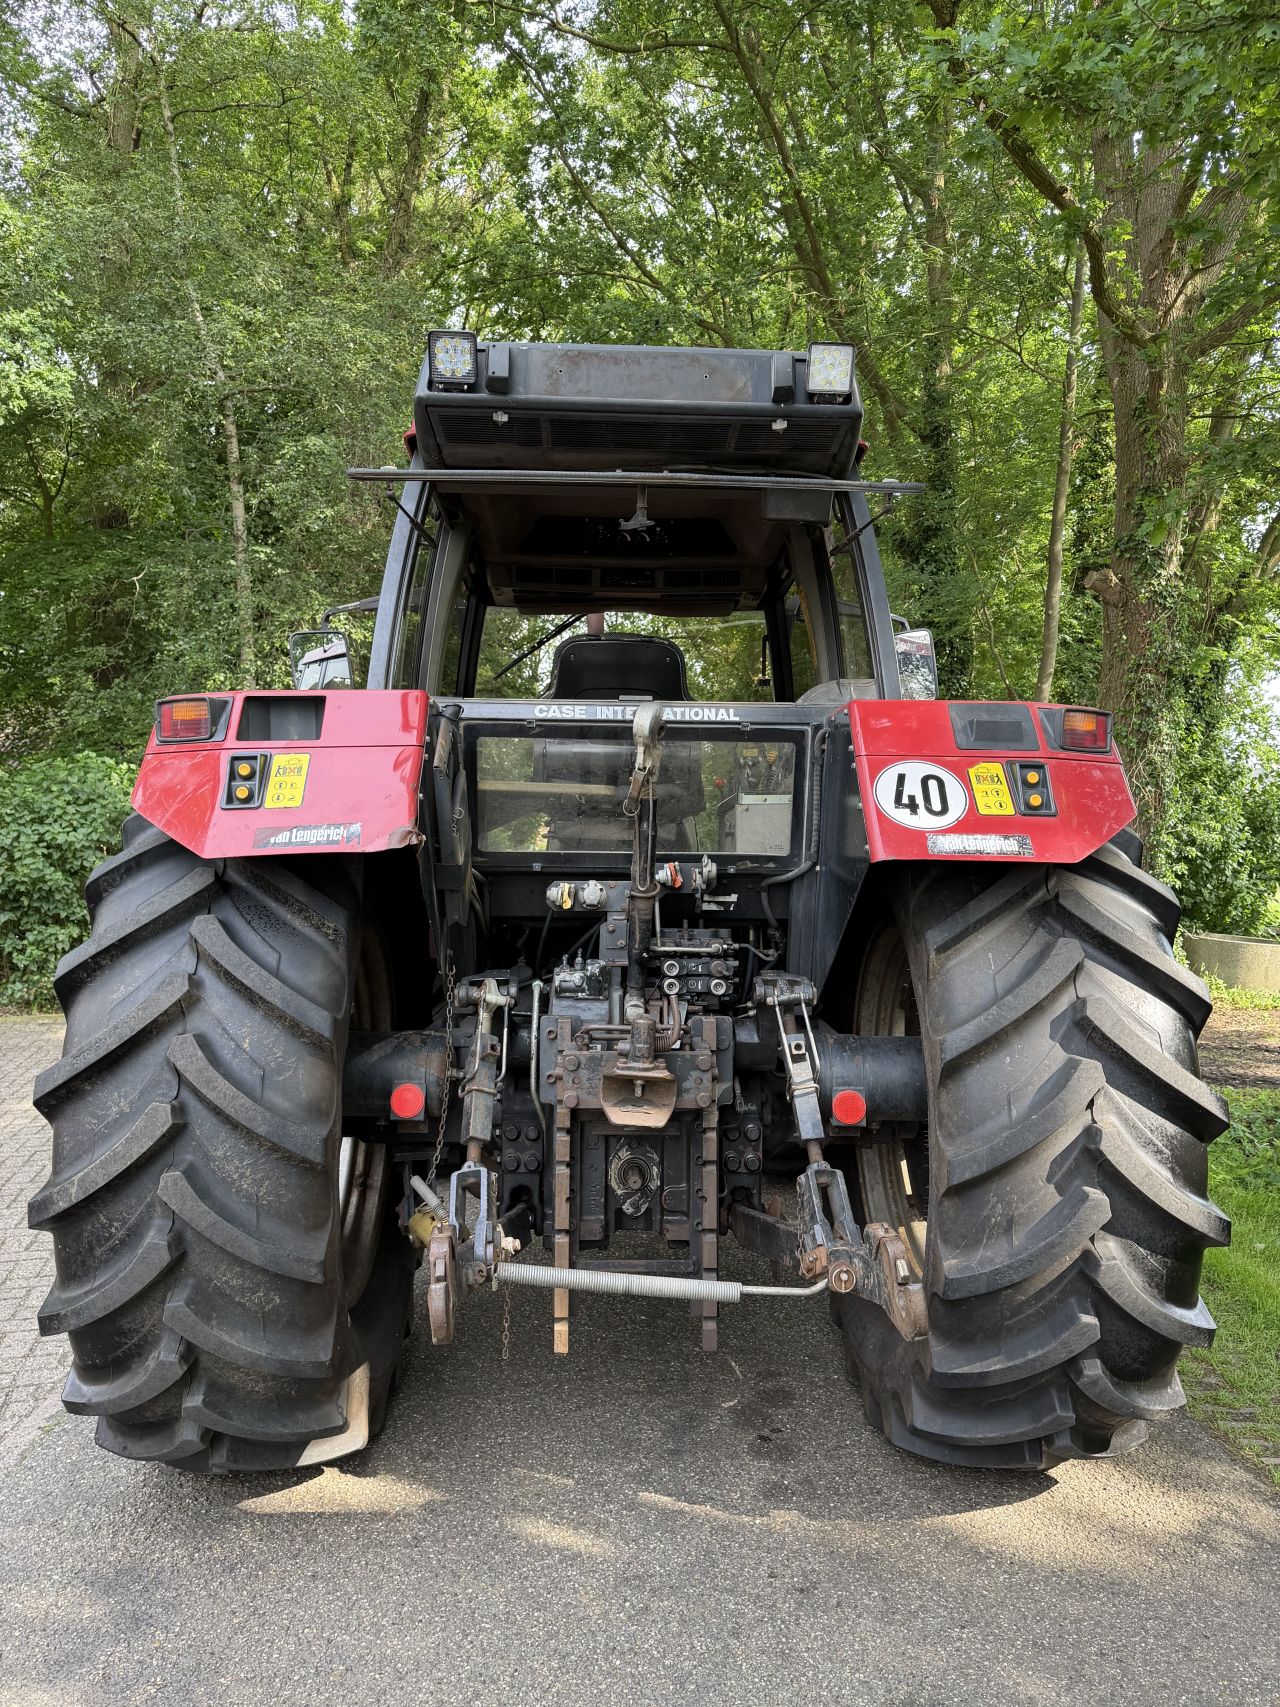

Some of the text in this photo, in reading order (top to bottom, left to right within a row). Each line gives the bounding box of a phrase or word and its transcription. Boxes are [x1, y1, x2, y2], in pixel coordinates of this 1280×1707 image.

[534, 705, 740, 721] CASE INTEATIONAL
[894, 773, 950, 817] 40
